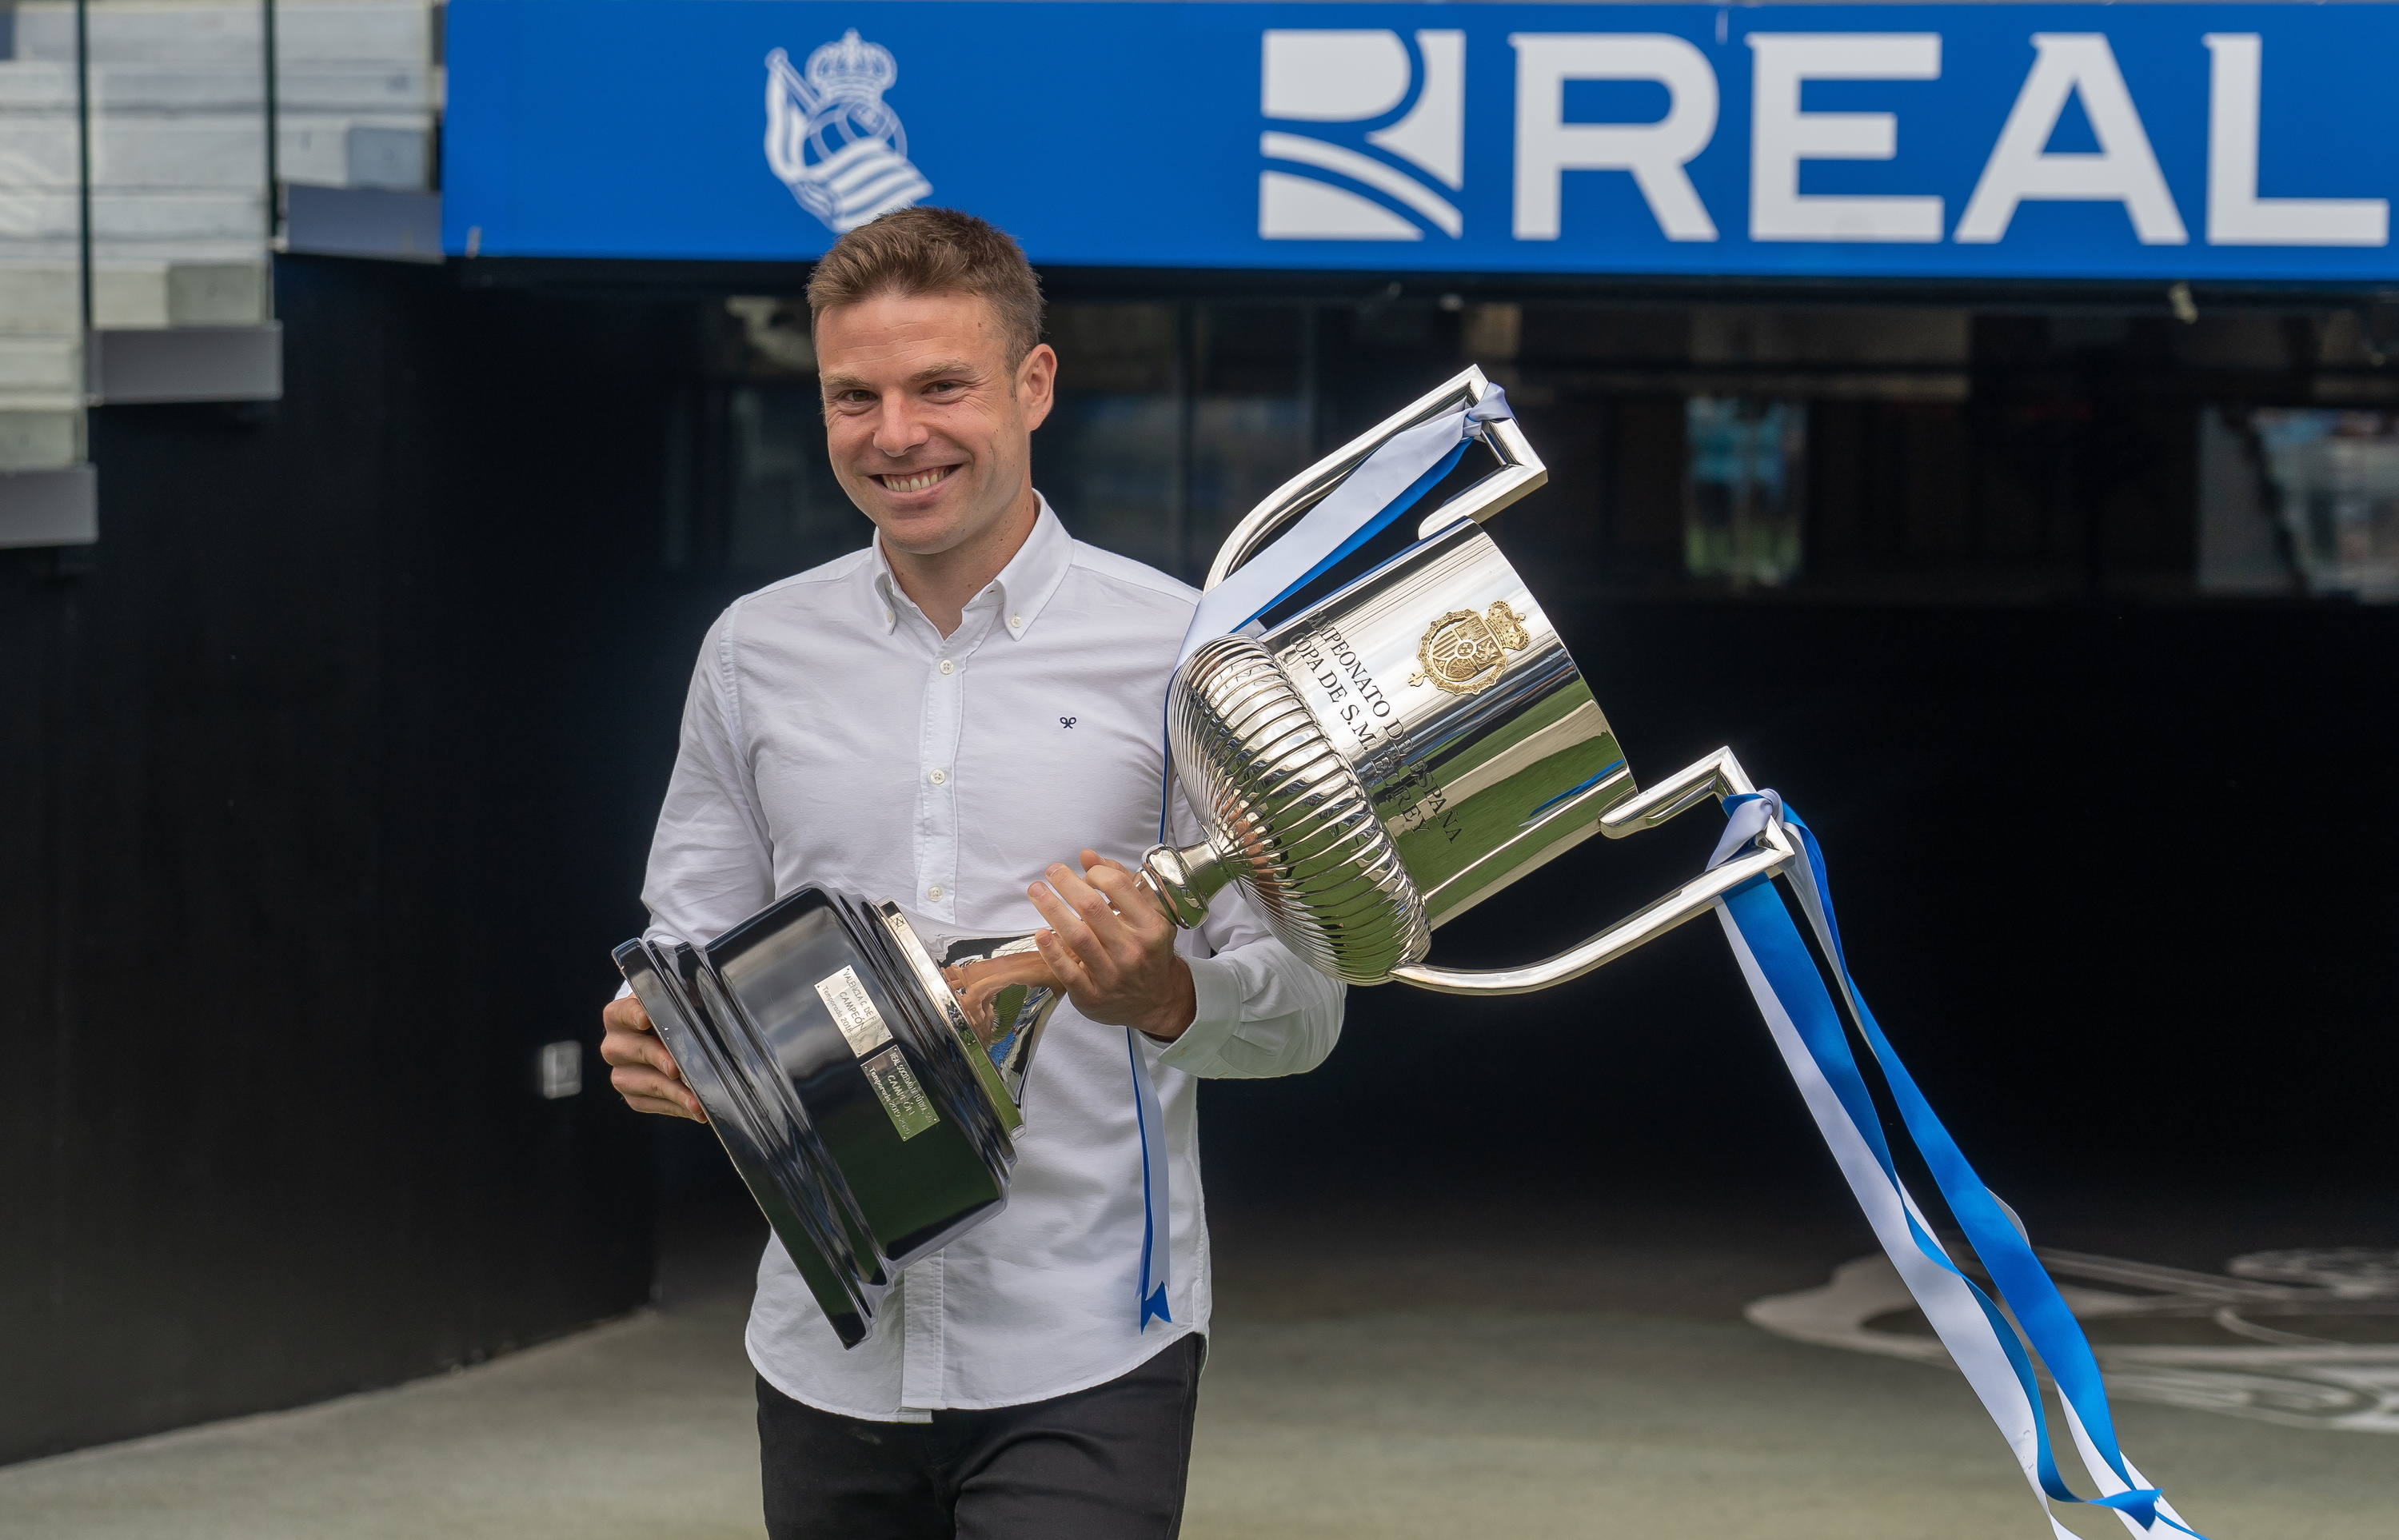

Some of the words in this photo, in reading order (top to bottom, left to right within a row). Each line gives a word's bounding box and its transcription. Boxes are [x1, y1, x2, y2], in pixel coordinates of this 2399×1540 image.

[1507, 32, 2389, 246] REAL
[1289, 632, 1323, 672] COPA
[1318, 669, 1347, 704] DE
[1389, 785, 1431, 836] REY
[1306, 609, 1391, 718] CAMPEONATO
[1383, 718, 1415, 757] DE
[1407, 755, 1464, 844] ESPAÑA
[822, 985, 843, 1017] Temporada
[839, 991, 867, 1031] CAMPEÓN
[843, 971, 863, 1000] VALENCIA
[864, 1006, 873, 1016] DE
[869, 1067, 892, 1102] Temporada
[889, 1052, 901, 1066] REAL
[896, 1064, 914, 1088] SOCIEDAD
[887, 1075, 916, 1115] CAMPEÓN
